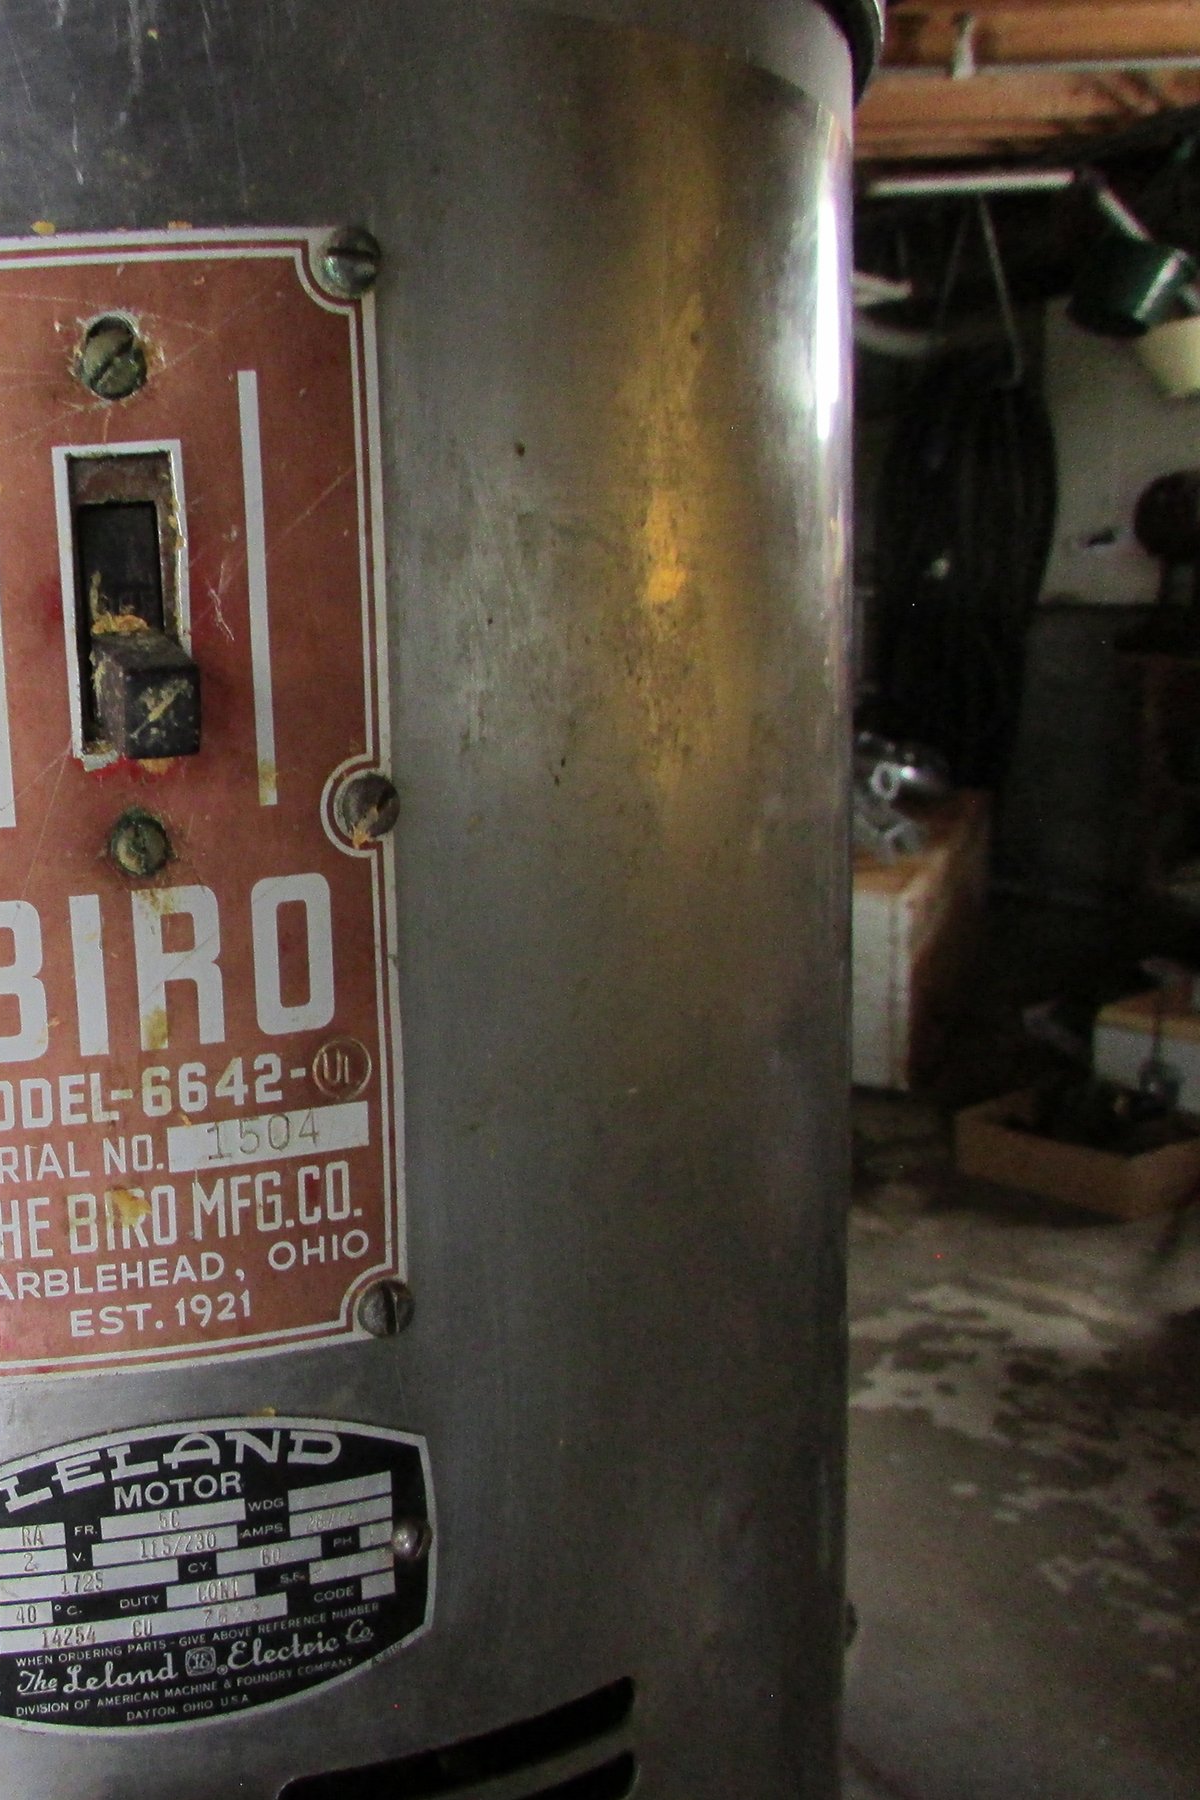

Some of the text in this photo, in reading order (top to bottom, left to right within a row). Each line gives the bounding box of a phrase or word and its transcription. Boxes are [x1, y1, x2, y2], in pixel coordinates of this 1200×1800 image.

[104, 1134, 164, 1173] NO.
[206, 1108, 321, 1161] 1504
[68, 1185, 177, 1256] BIRO
[267, 1229, 370, 1271] OHIO
[175, 1289, 252, 1328] 1921
[113, 1471, 242, 1510] MOTOR
[74, 1525, 98, 1536] FR.
[72, 1531, 217, 1562] V. 115/230
[60, 1572, 105, 1594] 1725
[187, 1562, 212, 1574] CY.
[119, 1595, 159, 1609] DUTY
[313, 1586, 355, 1603] CODE
[16, 1605, 37, 1624] 40
[16, 1655, 53, 1667] WHEN
[58, 1648, 122, 1663] ORDERING
[127, 1640, 167, 1653] PARTS
[179, 1634, 206, 1646] GIVE
[212, 1627, 251, 1641] ABOVE
[257, 1612, 327, 1633] REFERENCE
[332, 1602, 379, 1619] NUMBER
[42, 1626, 97, 1649] 14254
[16, 1669, 58, 1695] The
[62, 1652, 179, 1694] Leland
[227, 1631, 341, 1671] Electric
[16, 1702, 69, 1717] DIVISION
[74, 1700, 91, 1712] OF
[96, 1687, 159, 1707] AMERICAN
[164, 1681, 218, 1698] MACHINE
[237, 1670, 293, 1687] FOUNDRY
[183, 1700, 214, 1713] OHIO
